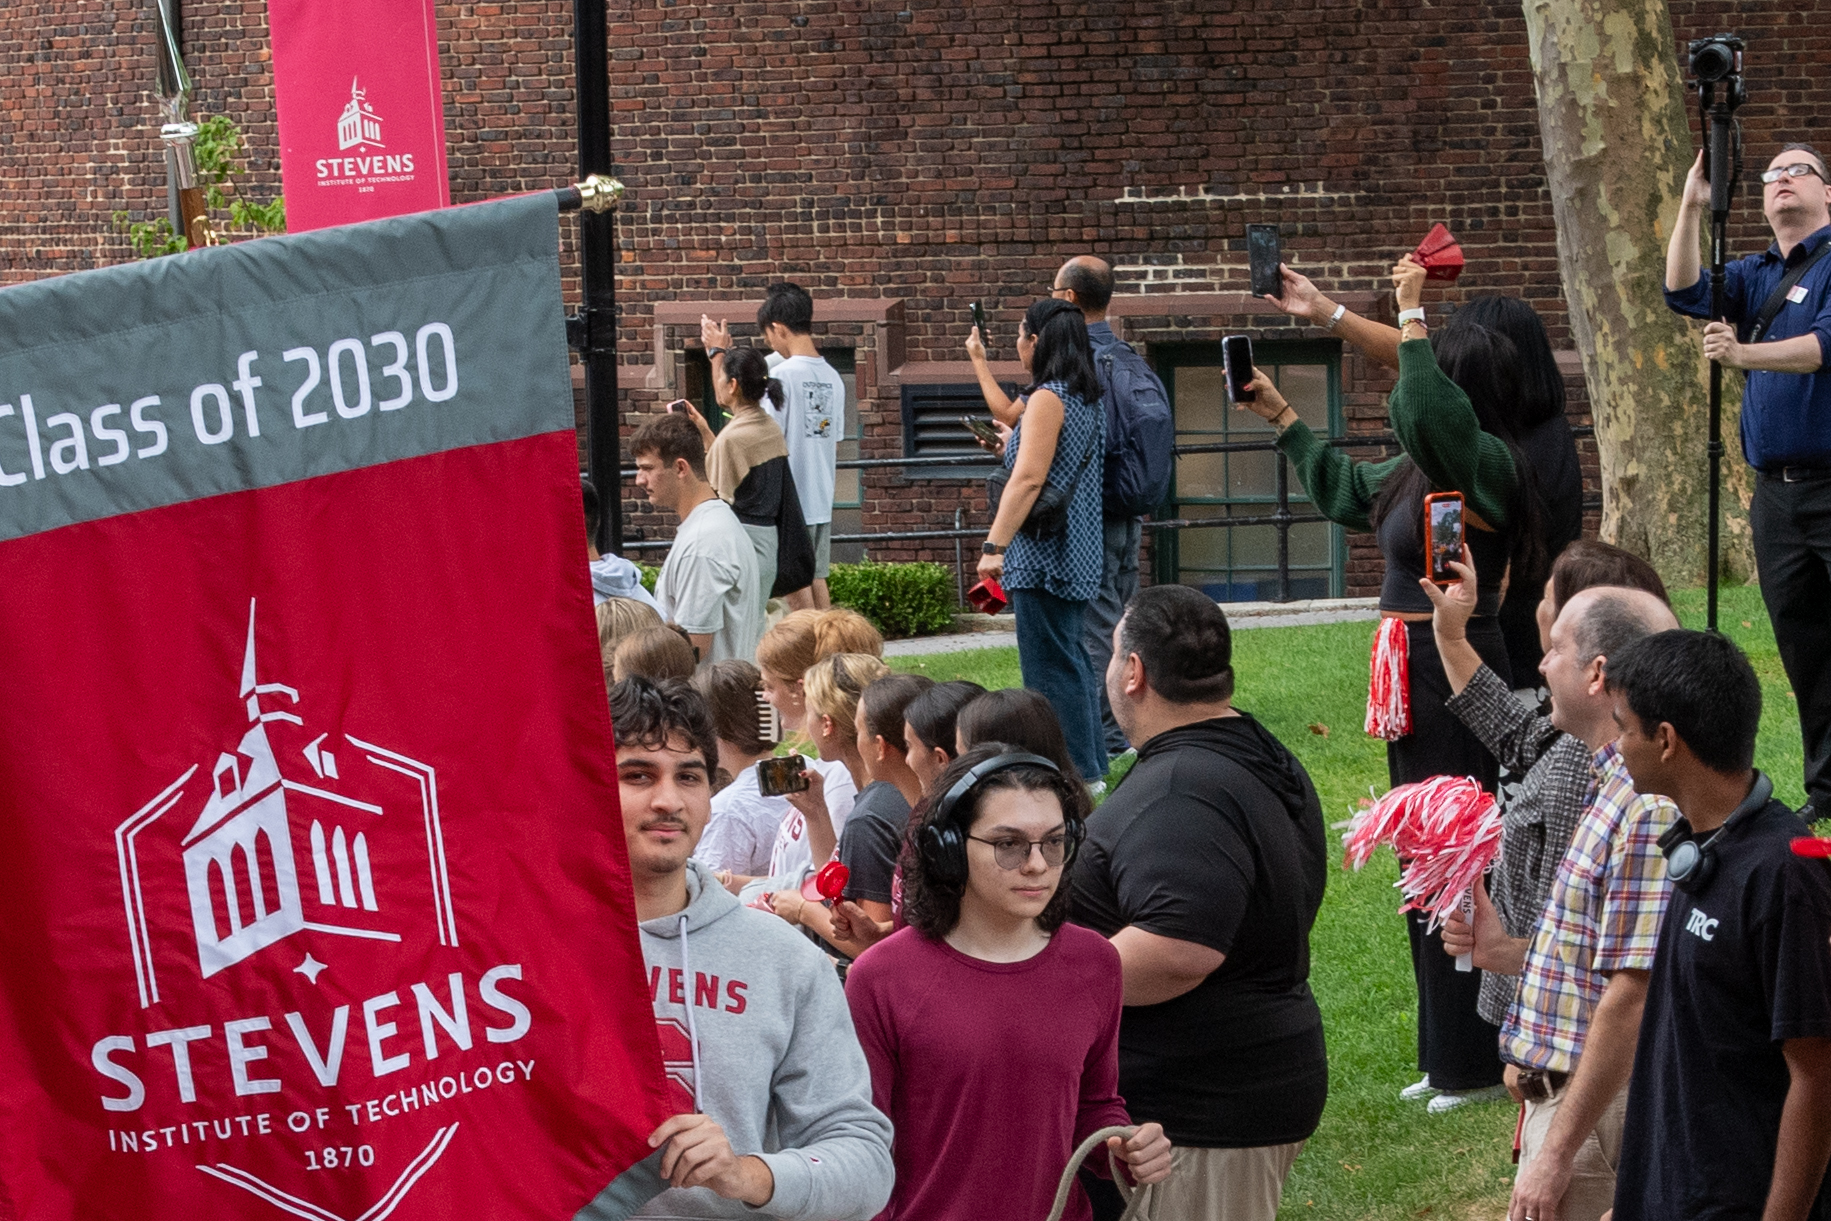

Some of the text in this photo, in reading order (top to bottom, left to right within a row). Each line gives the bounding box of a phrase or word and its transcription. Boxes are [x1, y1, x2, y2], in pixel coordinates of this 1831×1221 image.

[315, 153, 415, 178] STEVENS
[317, 179, 354, 187] INSTITUTE
[367, 174, 415, 184] TECHNOLOGY
[189, 350, 263, 445] of
[282, 322, 459, 429] 2030
[1686, 907, 1719, 941] TRC
[91, 963, 533, 1112] STEVENS
[108, 1059, 536, 1154] INSTITUTE OF TECHNOLOGY
[305, 1144, 375, 1171] 1870
